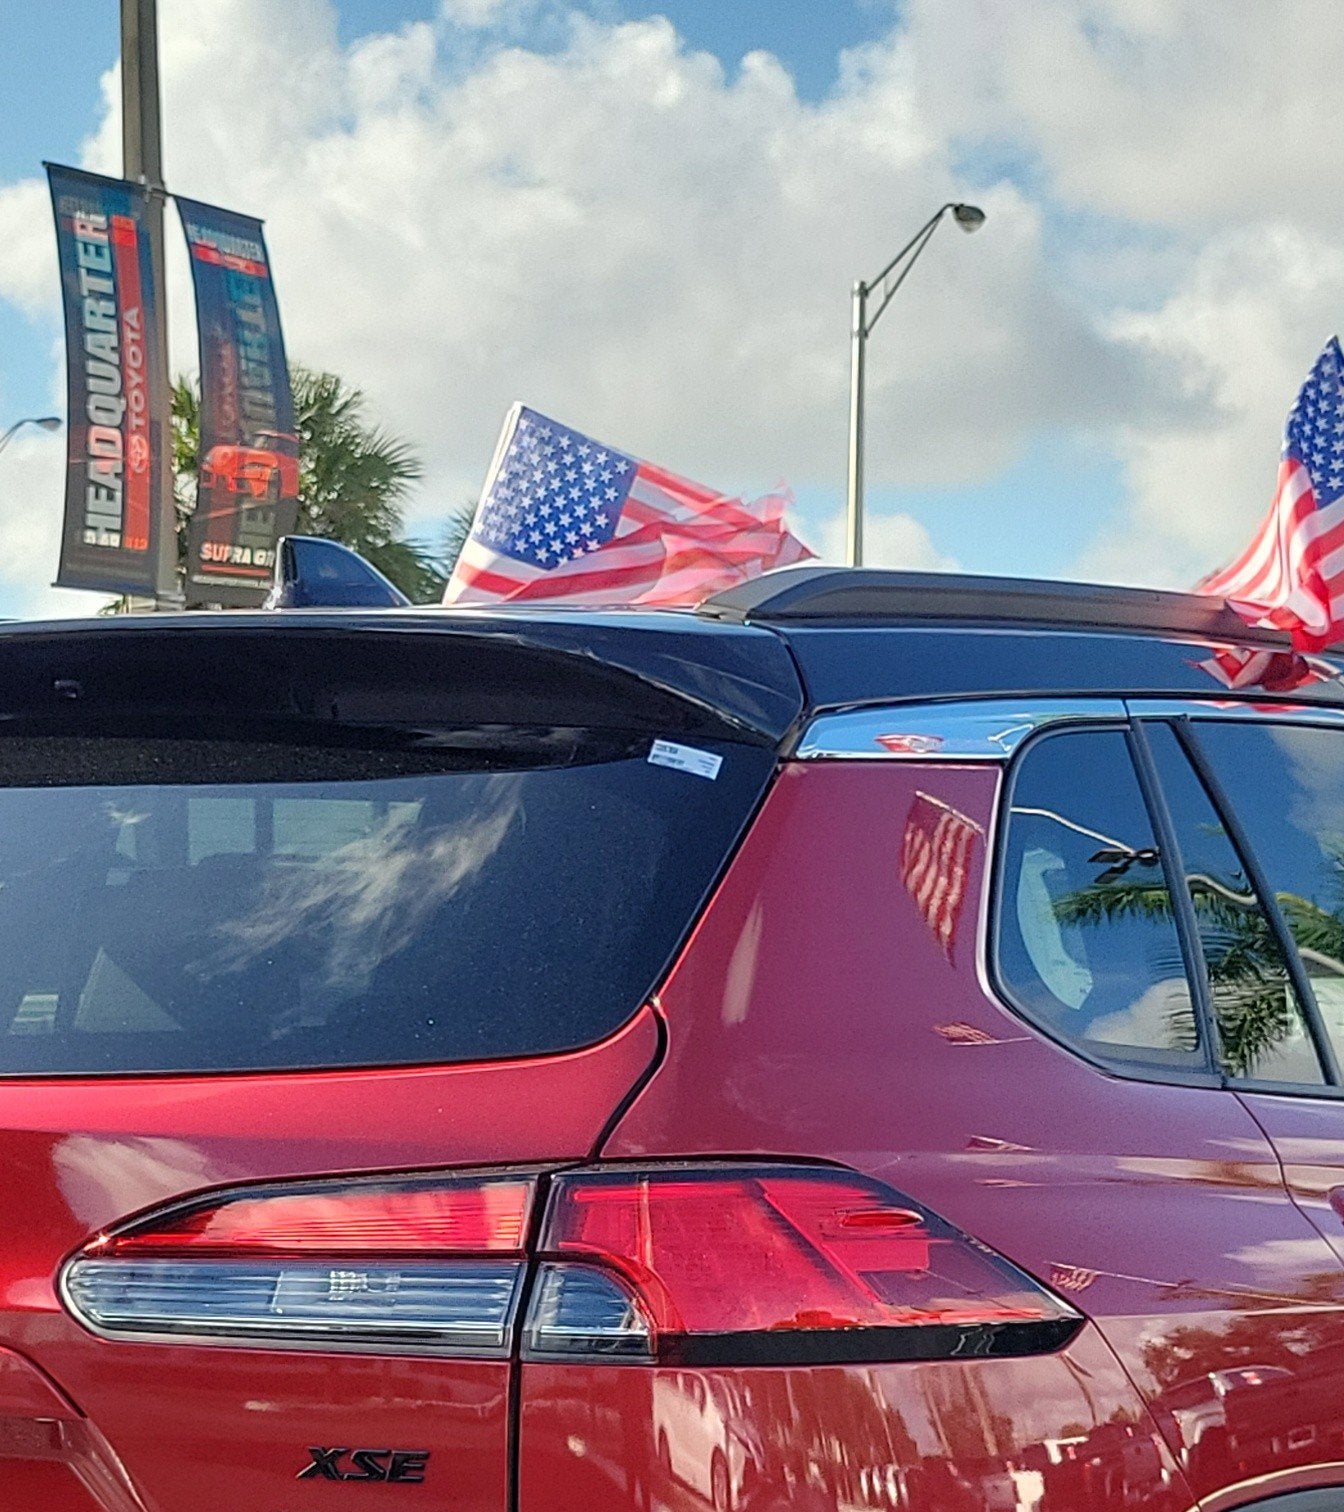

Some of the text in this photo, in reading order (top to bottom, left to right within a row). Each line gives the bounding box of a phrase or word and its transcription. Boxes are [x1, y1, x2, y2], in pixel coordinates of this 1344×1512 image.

[74, 213, 125, 546] HEADQUARTER
[123, 308, 145, 432] TOYOTA
[200, 542, 251, 565] SUPRA
[295, 1447, 431, 1483] XSE
